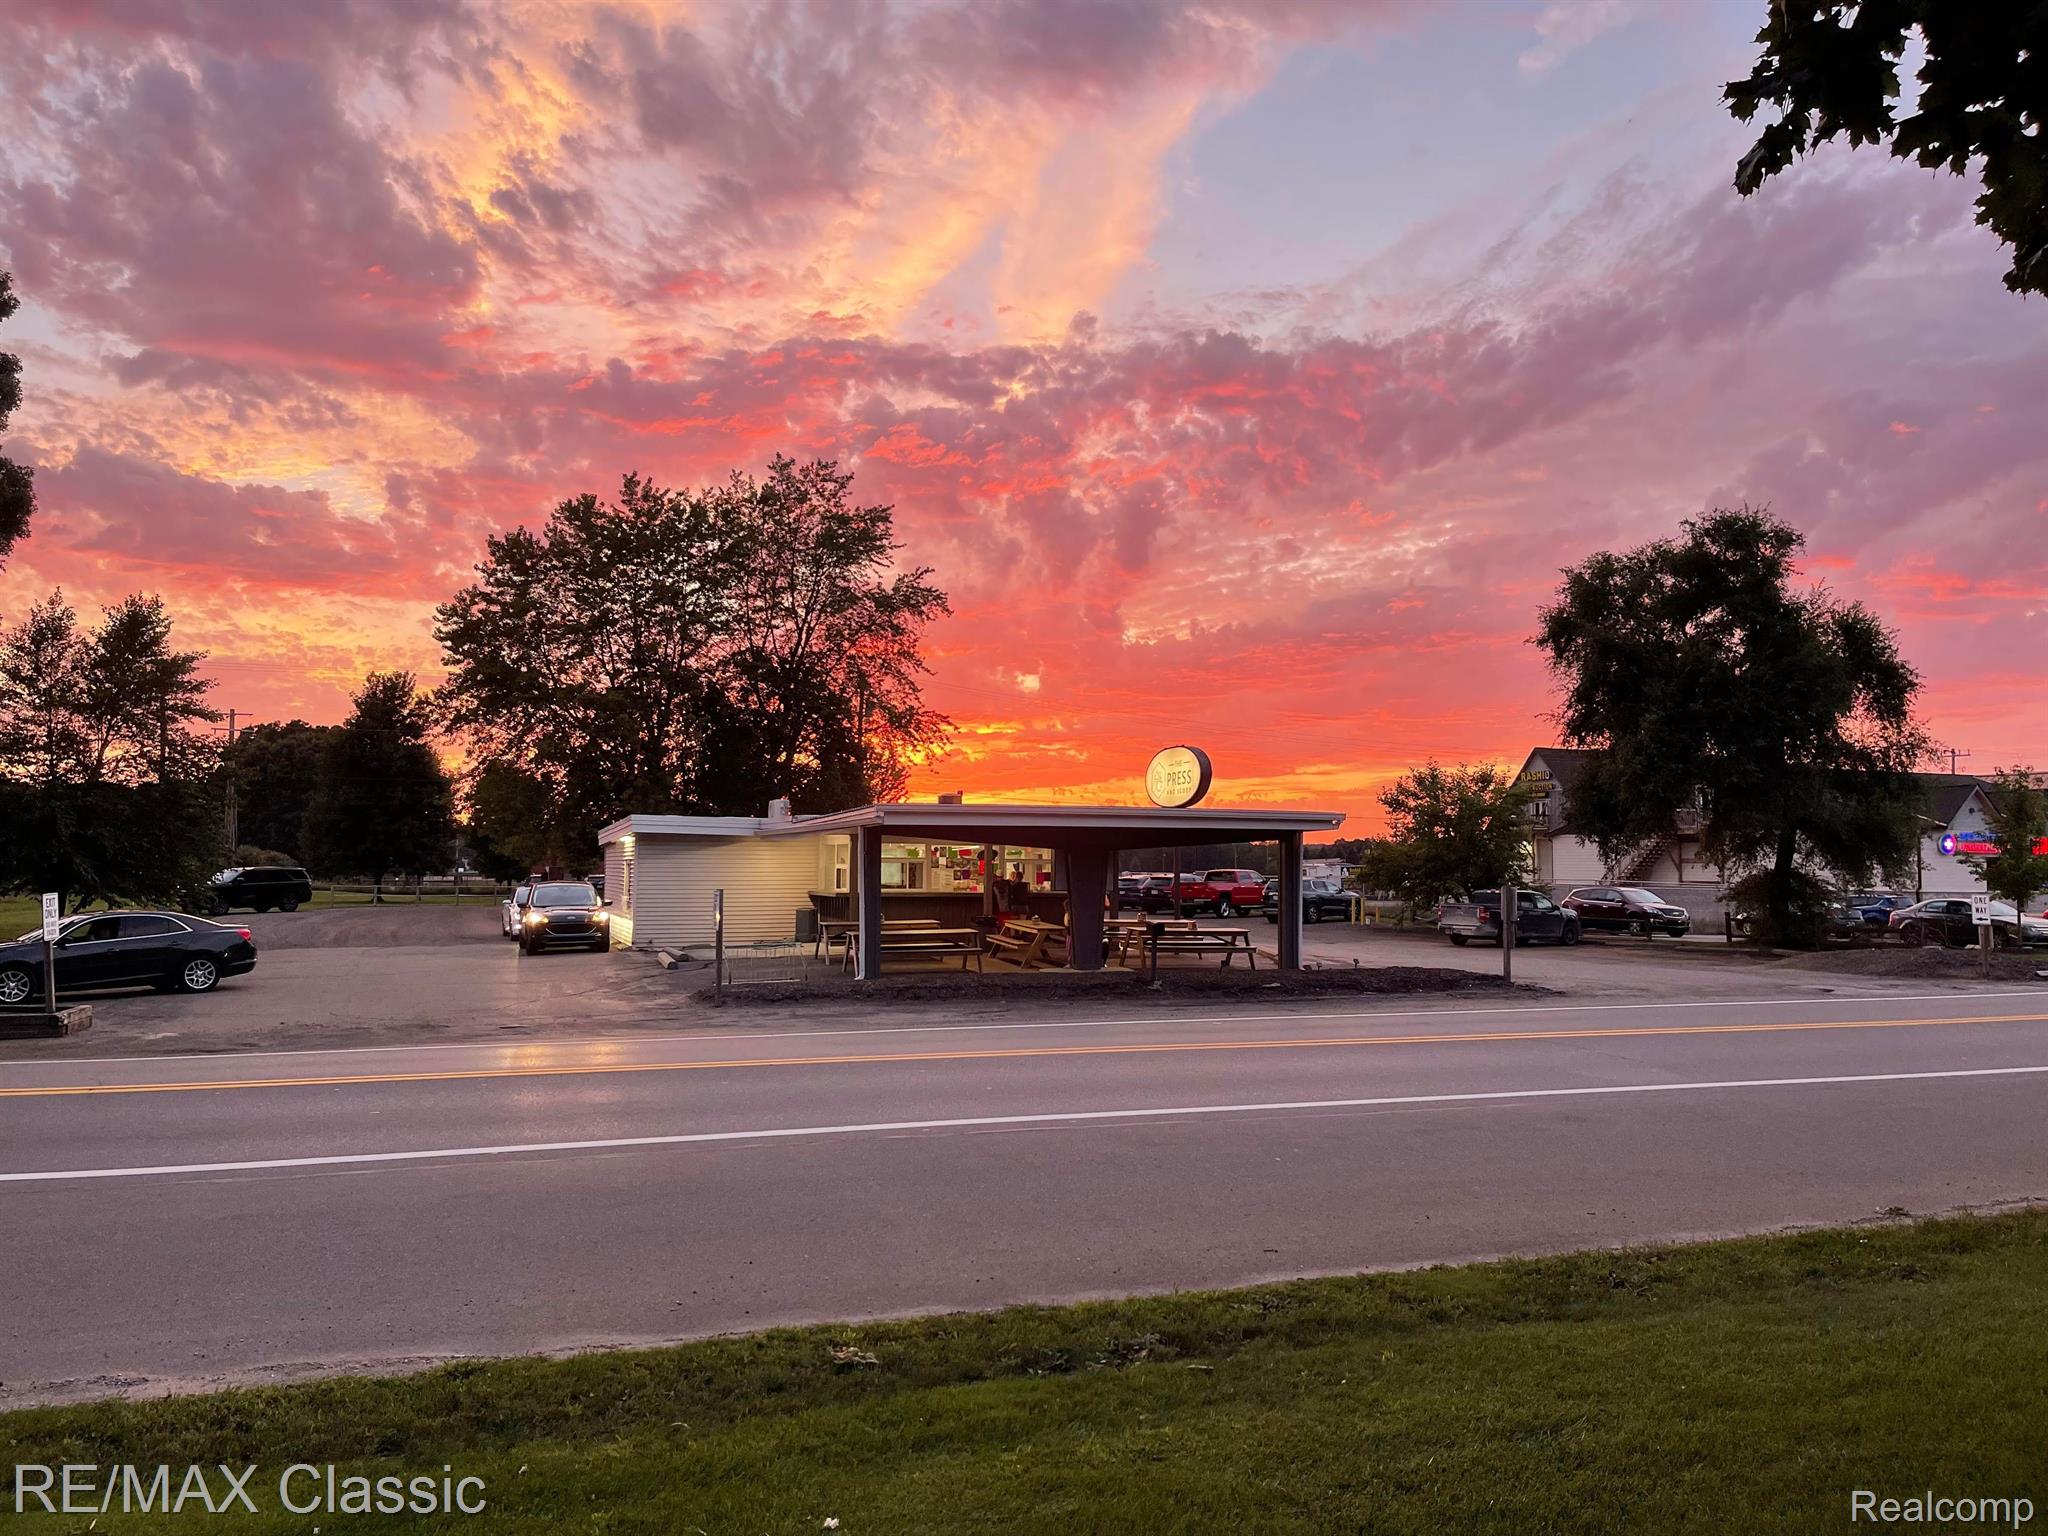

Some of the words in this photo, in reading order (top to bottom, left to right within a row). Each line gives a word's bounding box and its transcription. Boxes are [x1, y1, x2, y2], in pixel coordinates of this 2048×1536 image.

[1167, 769, 1192, 786] PRESS
[45, 898, 56, 908] EXIT
[1974, 896, 1987, 904] ONE
[45, 909, 57, 919] ONLY
